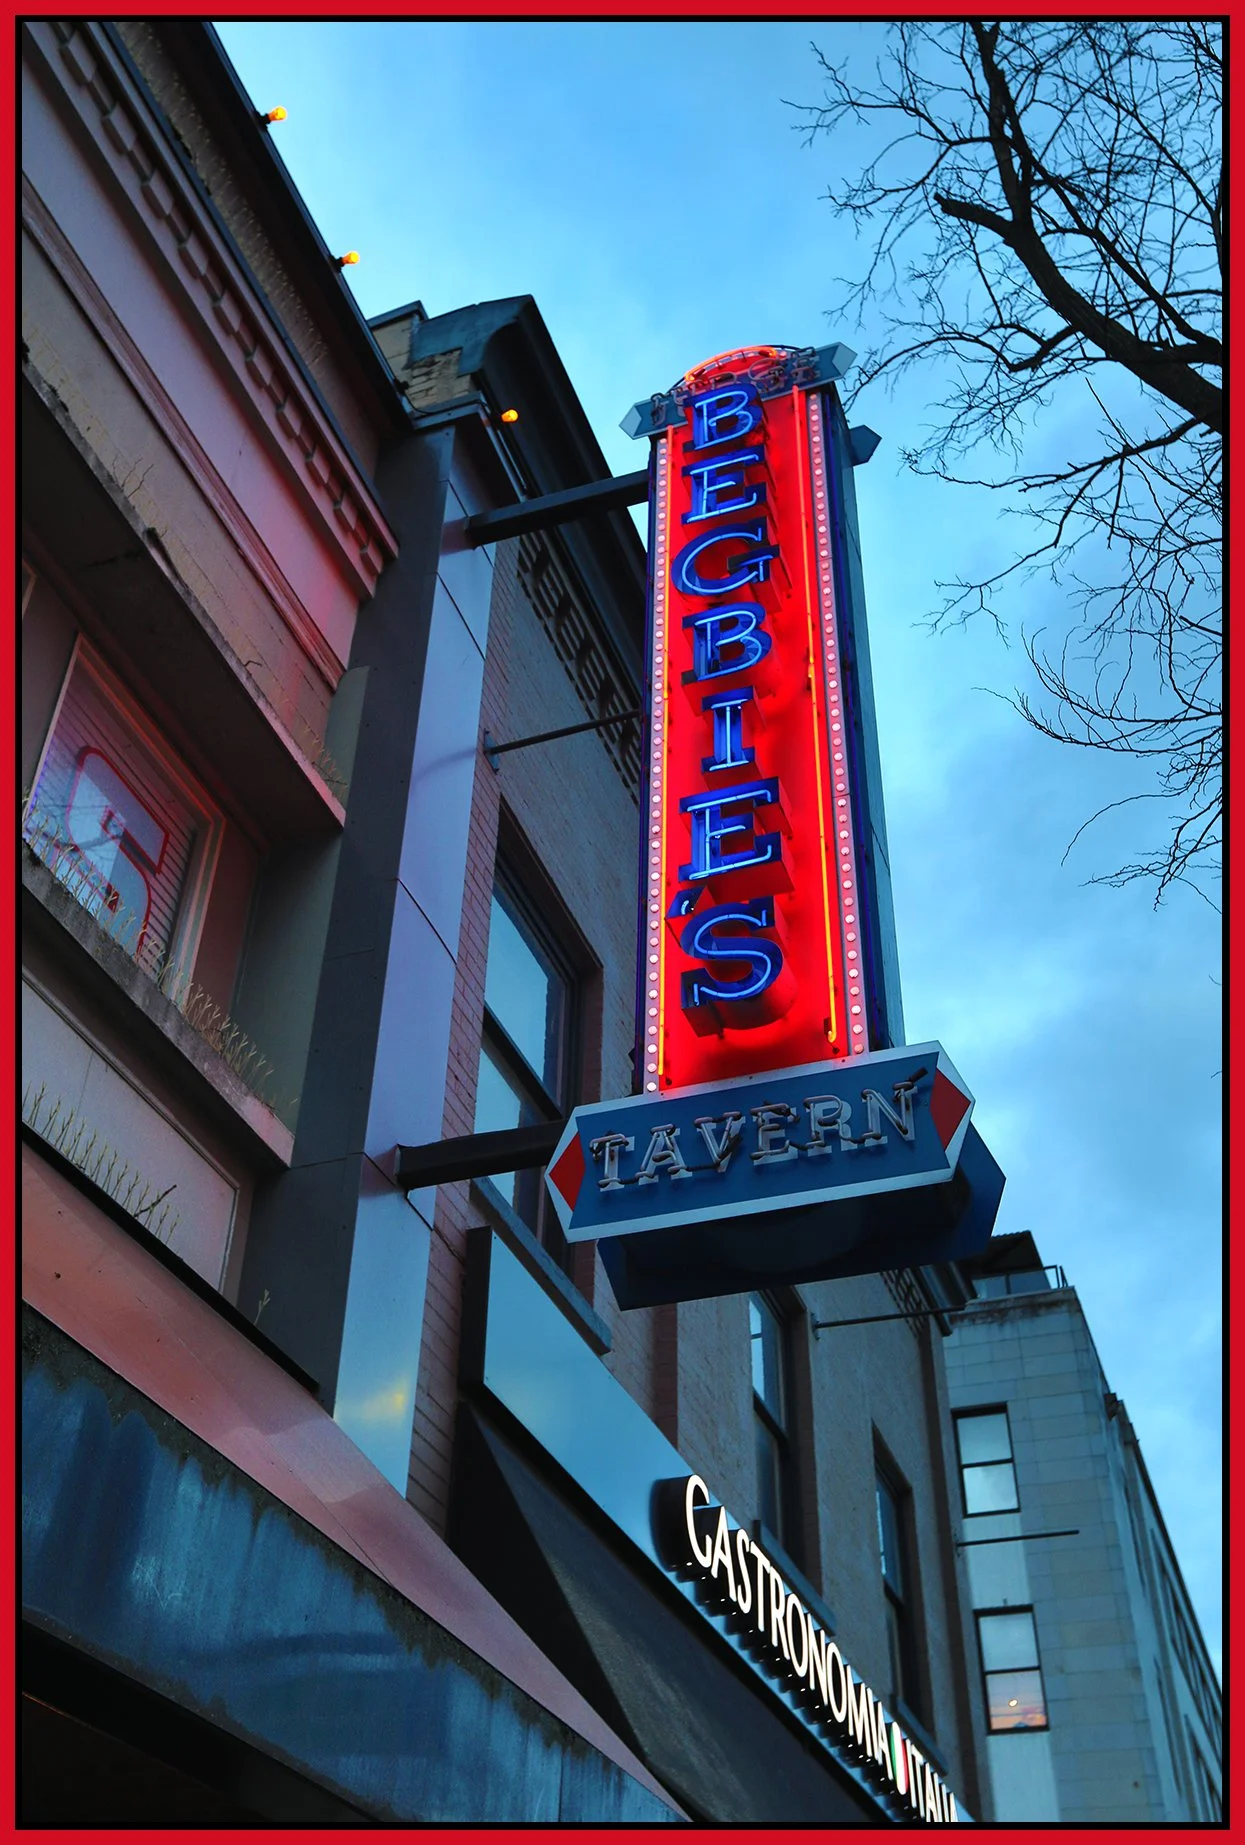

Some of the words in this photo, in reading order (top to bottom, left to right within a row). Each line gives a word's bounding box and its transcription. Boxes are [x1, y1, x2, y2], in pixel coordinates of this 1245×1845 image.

[666, 383, 783, 1007] BEGBIE'S
[589, 1082, 918, 1192] TAVERN
[686, 1474, 894, 1781] GASTRONOMIA
